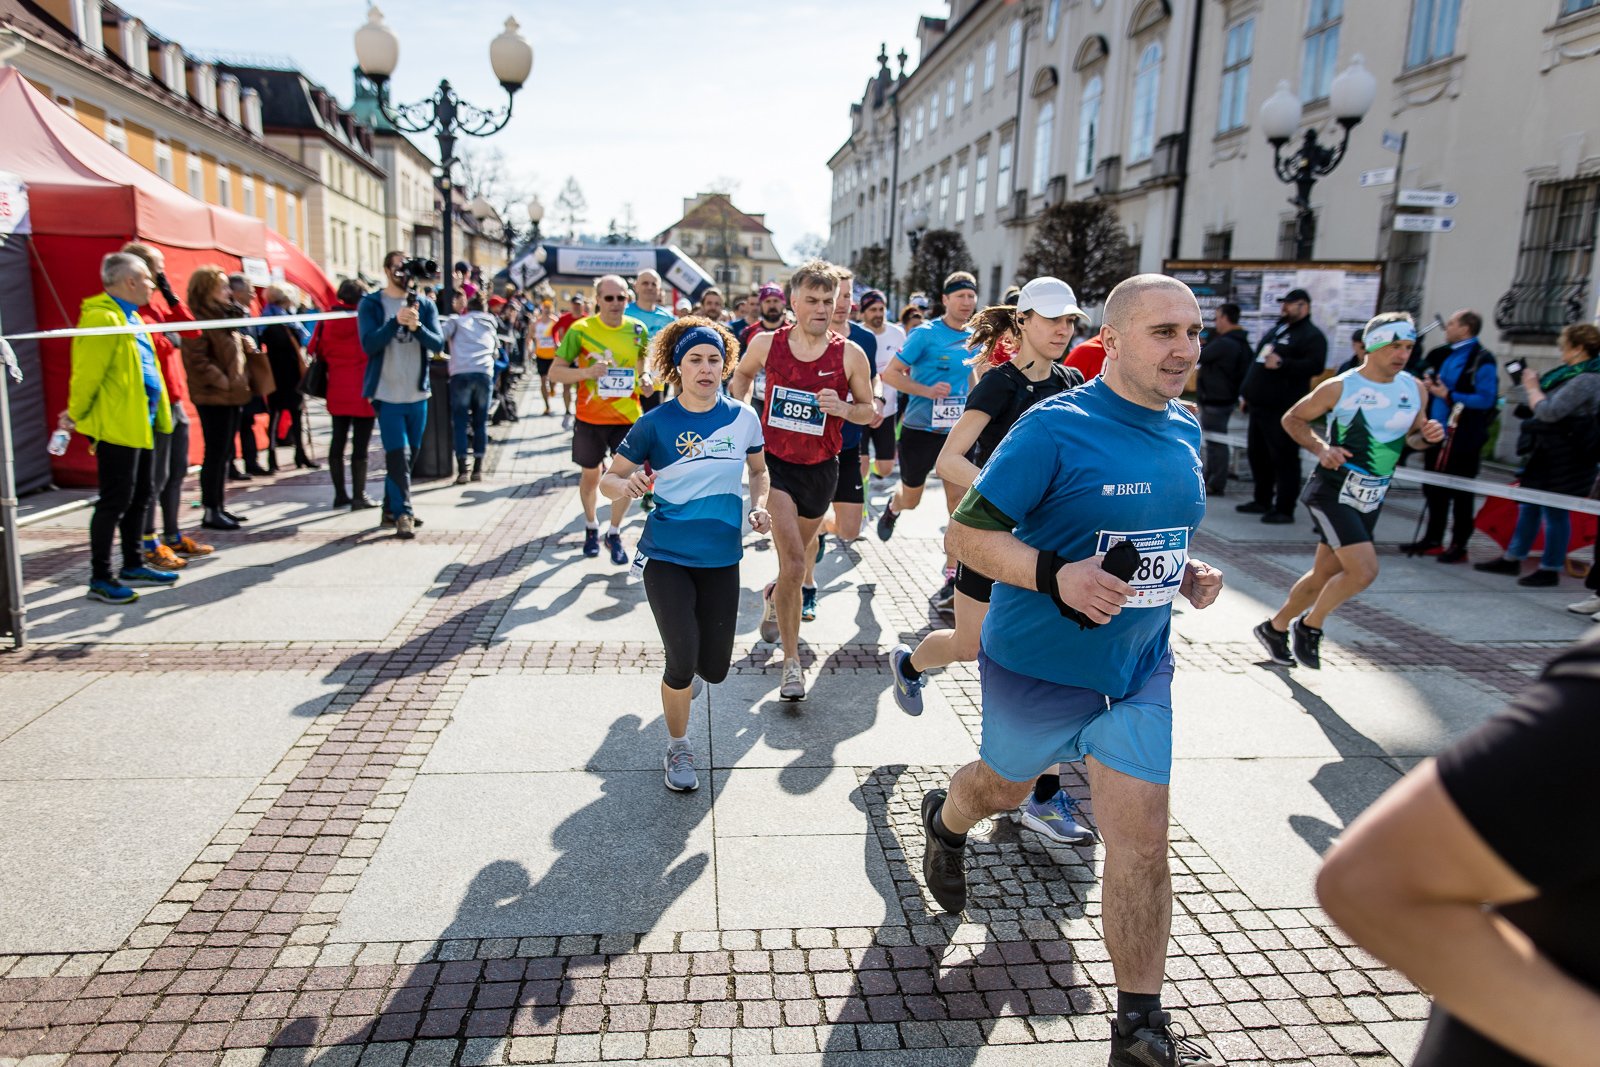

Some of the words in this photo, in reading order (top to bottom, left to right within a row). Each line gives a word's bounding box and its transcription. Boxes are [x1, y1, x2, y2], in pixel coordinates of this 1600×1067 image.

[612, 378, 624, 387] 75
[783, 402, 812, 420] 895
[943, 407, 960, 417] 453
[1116, 482, 1152, 495] BRITA
[1131, 555, 1165, 581] 86
